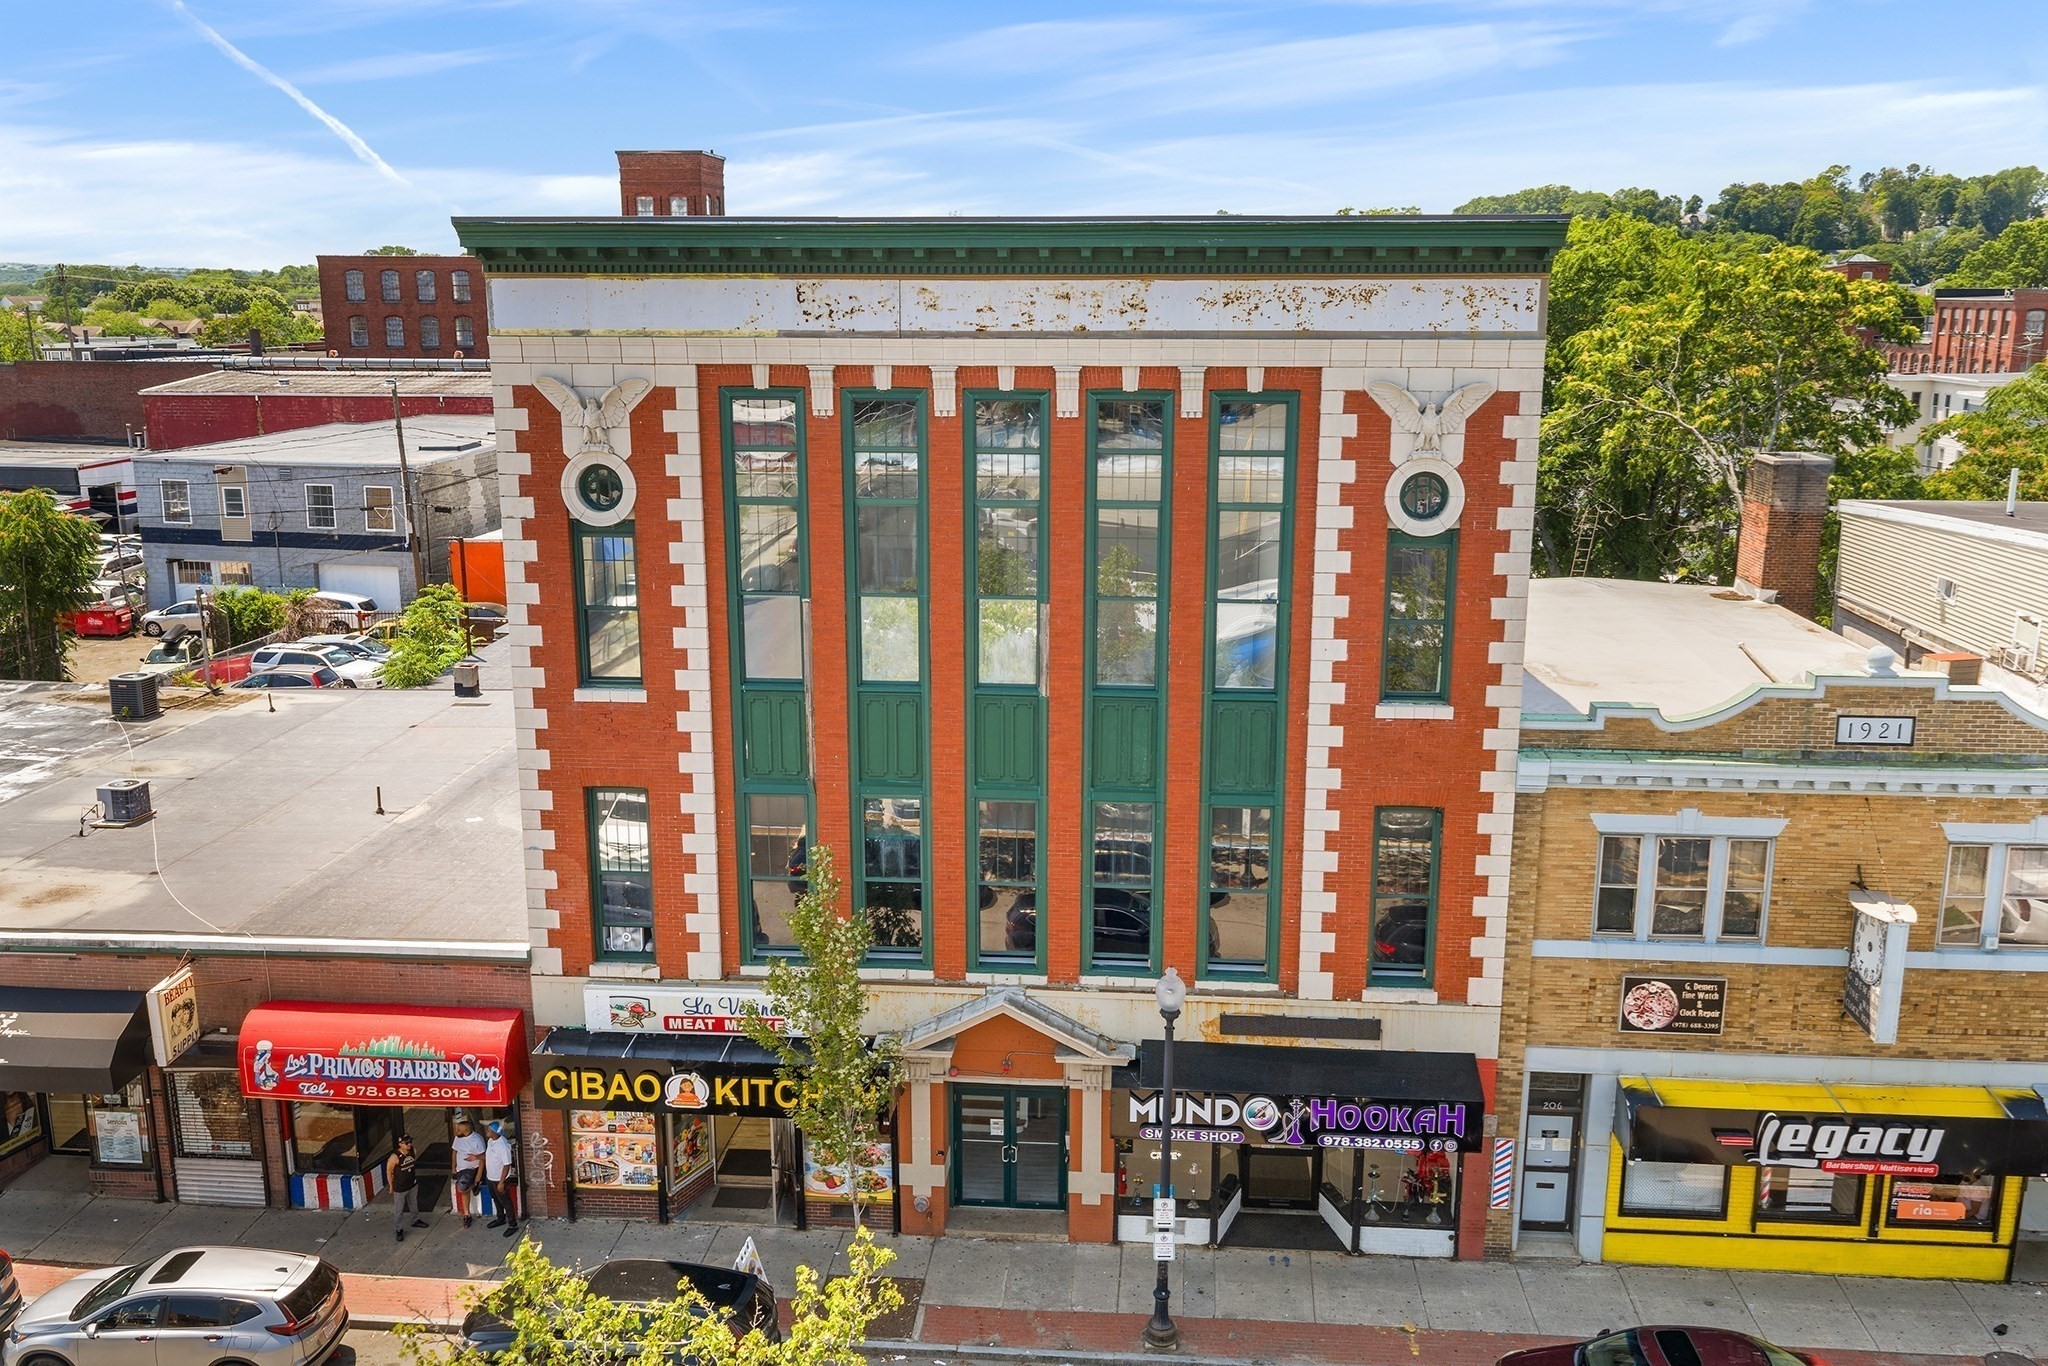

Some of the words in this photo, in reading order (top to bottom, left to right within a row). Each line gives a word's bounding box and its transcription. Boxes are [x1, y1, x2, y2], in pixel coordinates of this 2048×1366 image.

[1848, 722, 1902, 739] 1921
[163, 976, 194, 1006] BEAUTY
[1693, 982, 1718, 991] Demers
[1682, 991, 1696, 999] Fine
[1698, 992, 1719, 1000] Watch
[683, 998, 713, 1016] La
[1696, 1001, 1703, 1009] &
[1679, 1009, 1696, 1017] Clock
[1698, 1009, 1720, 1018] Repair
[668, 1018, 715, 1030] MEAT
[172, 1029, 199, 1057] SUPPLY
[284, 1054, 307, 1078] Los
[307, 1053, 385, 1080] PRIMOS
[387, 1057, 462, 1082] BARBER
[460, 1054, 502, 1093] Shop
[346, 1086, 470, 1099] 978.682.3012
[543, 1070, 661, 1103] CIBAO
[715, 1078, 876, 1110] KITCH
[1543, 1101, 1563, 1110] 206
[1310, 1099, 1466, 1138] HOOKAH
[1200, 1131, 1240, 1142] SHOP
[1323, 1136, 1420, 1149] 978.382.0555
[1748, 1112, 1945, 1168] Legacy
[1825, 1161, 1875, 1171] Barbershop
[1880, 1164, 1935, 1174] Multiservices
[1912, 1204, 1932, 1215] ria
